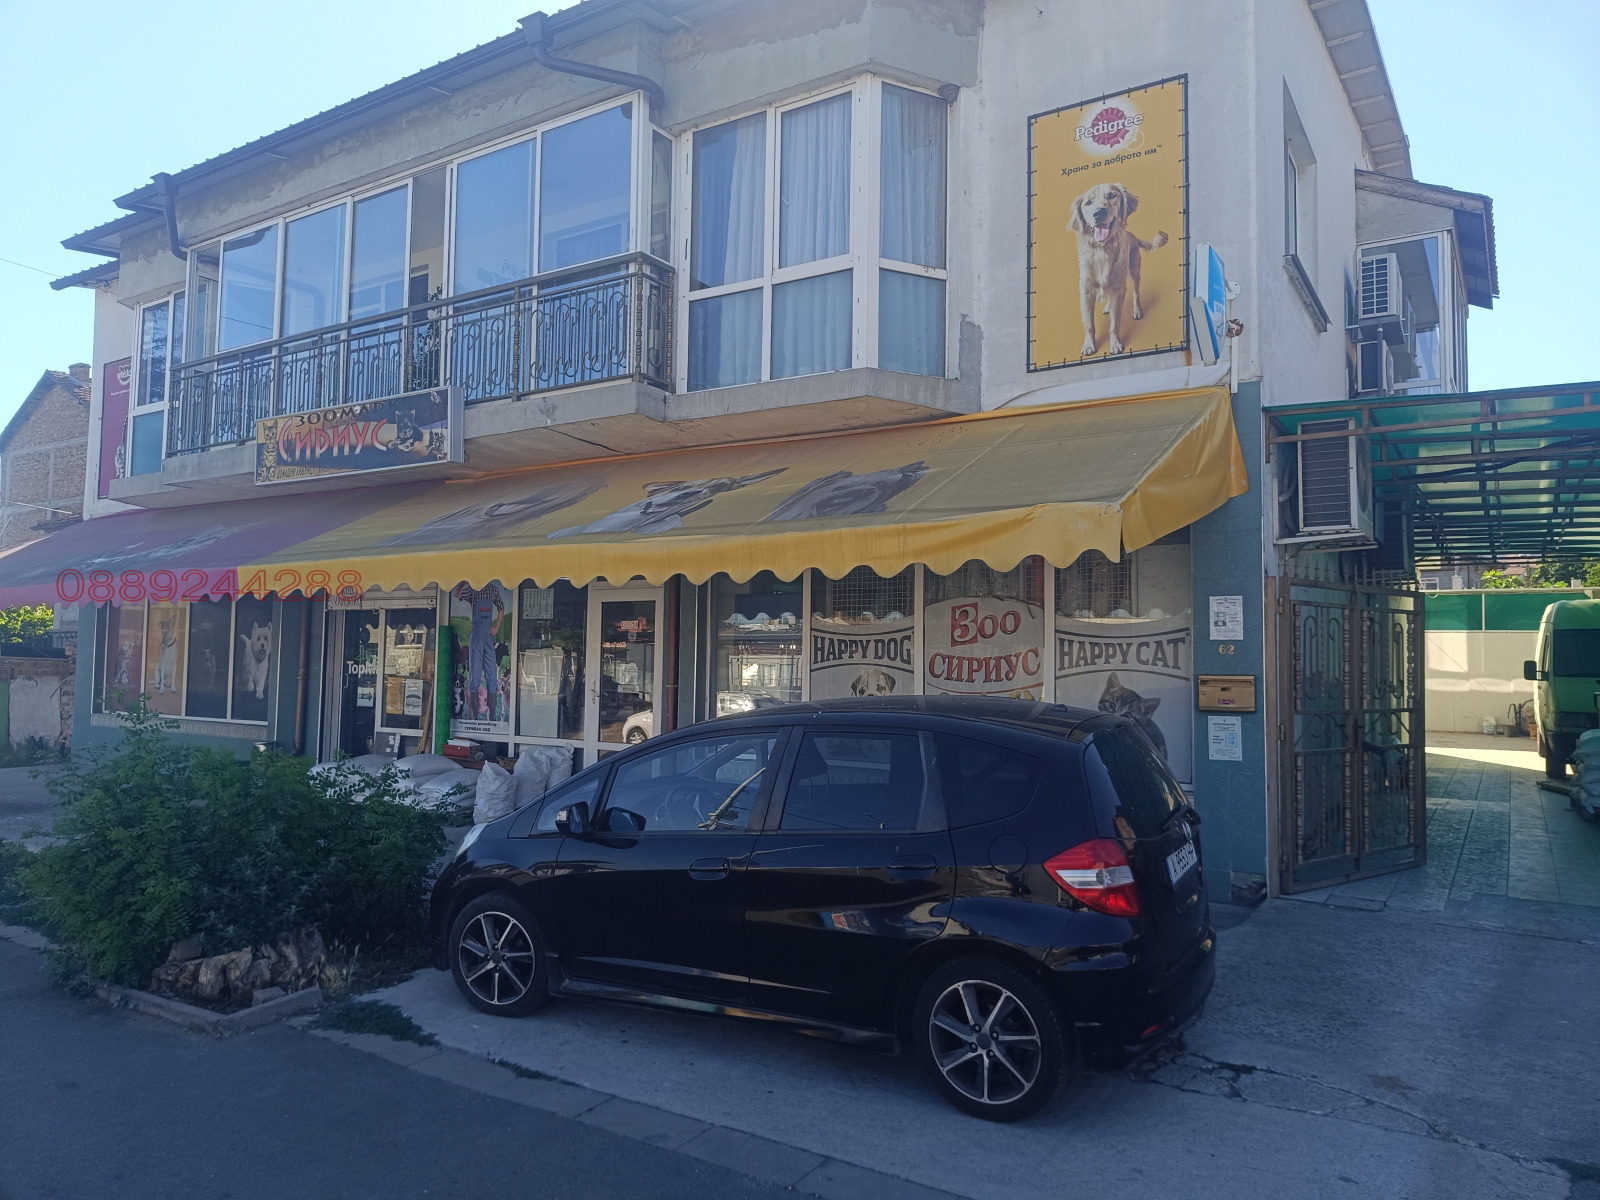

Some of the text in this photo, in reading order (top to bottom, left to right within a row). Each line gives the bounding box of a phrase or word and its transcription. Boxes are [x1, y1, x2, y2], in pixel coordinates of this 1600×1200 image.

[1074, 114, 1144, 141] Pedigree
[1061, 164, 1089, 177] Храна
[1092, 161, 1102, 169] за
[1104, 152, 1142, 166] доброто
[812, 634, 912, 666] HAPPY DOG
[1057, 636, 1186, 672] HAPPY CAT
[1218, 643, 1236, 655] 62
[929, 647, 1041, 683] СИРИУС
